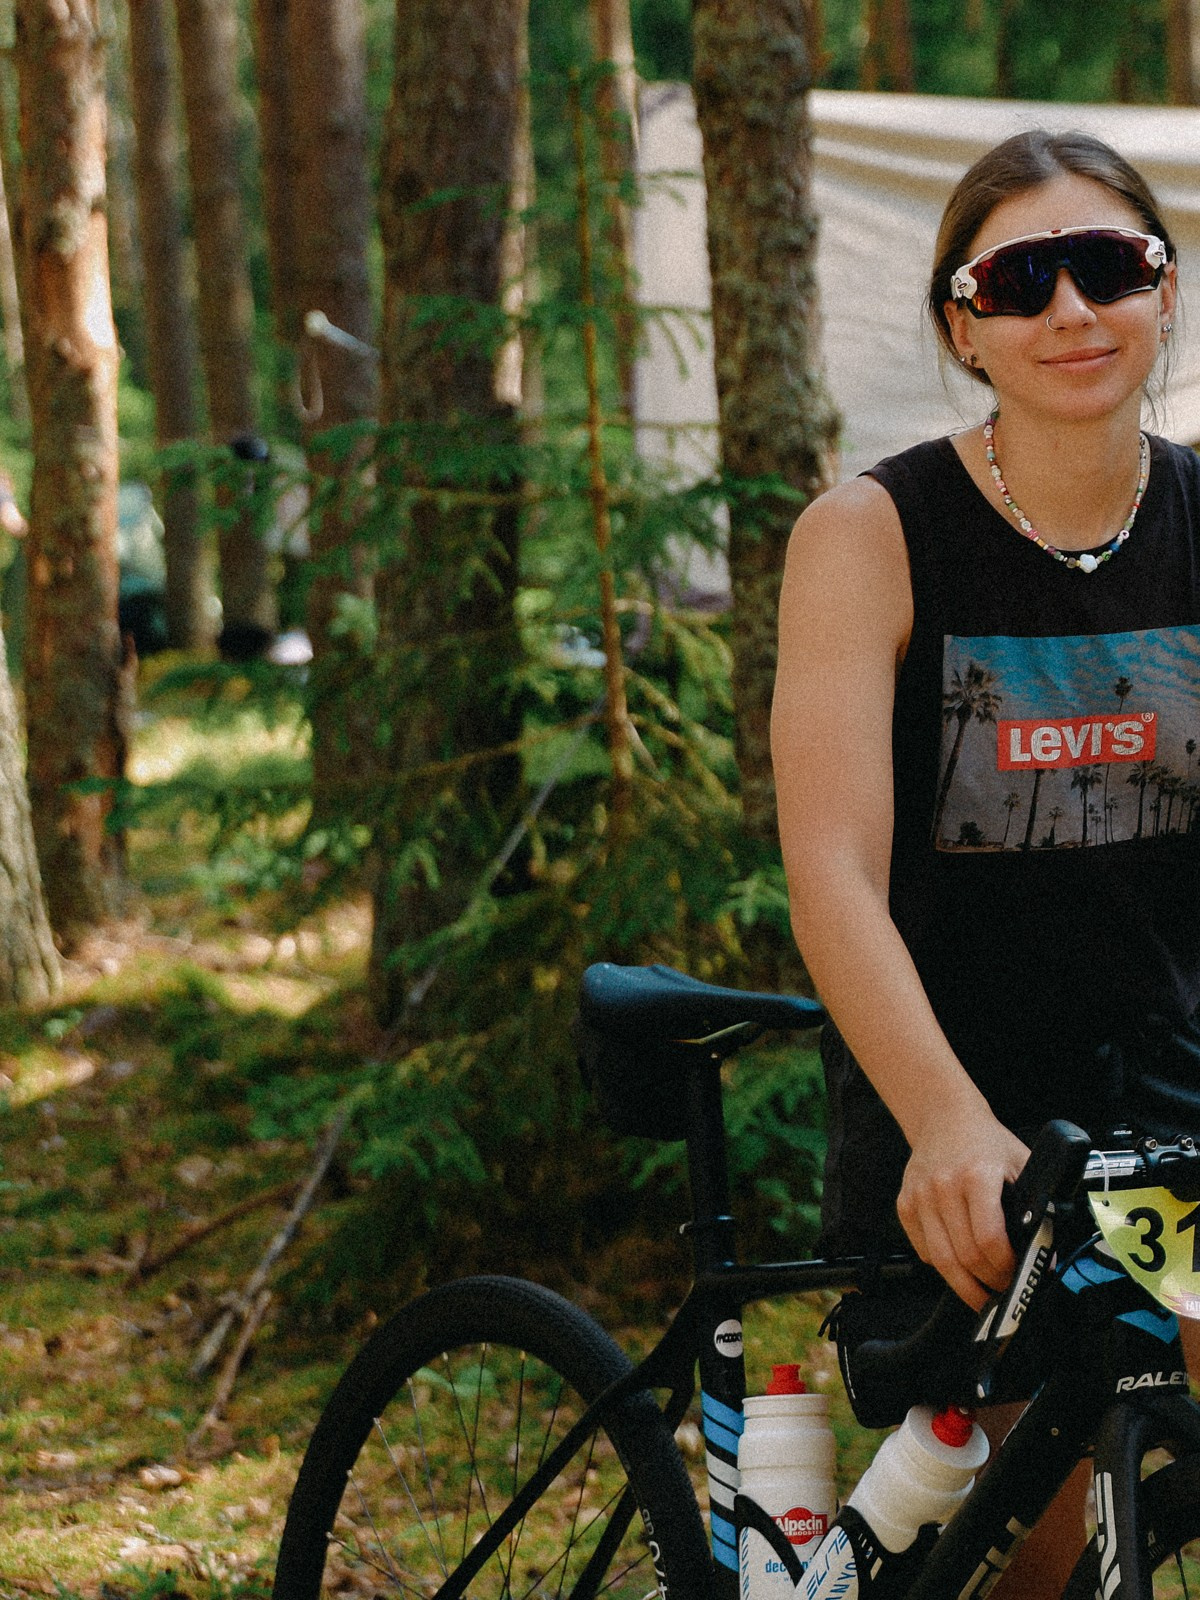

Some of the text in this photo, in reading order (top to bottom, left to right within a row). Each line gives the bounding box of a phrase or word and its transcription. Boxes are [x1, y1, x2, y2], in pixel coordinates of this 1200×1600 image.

[1011, 1245, 1048, 1322] SRAM
[1116, 1371, 1190, 1393] RALEI
[776, 1515, 823, 1536] Alpecin
